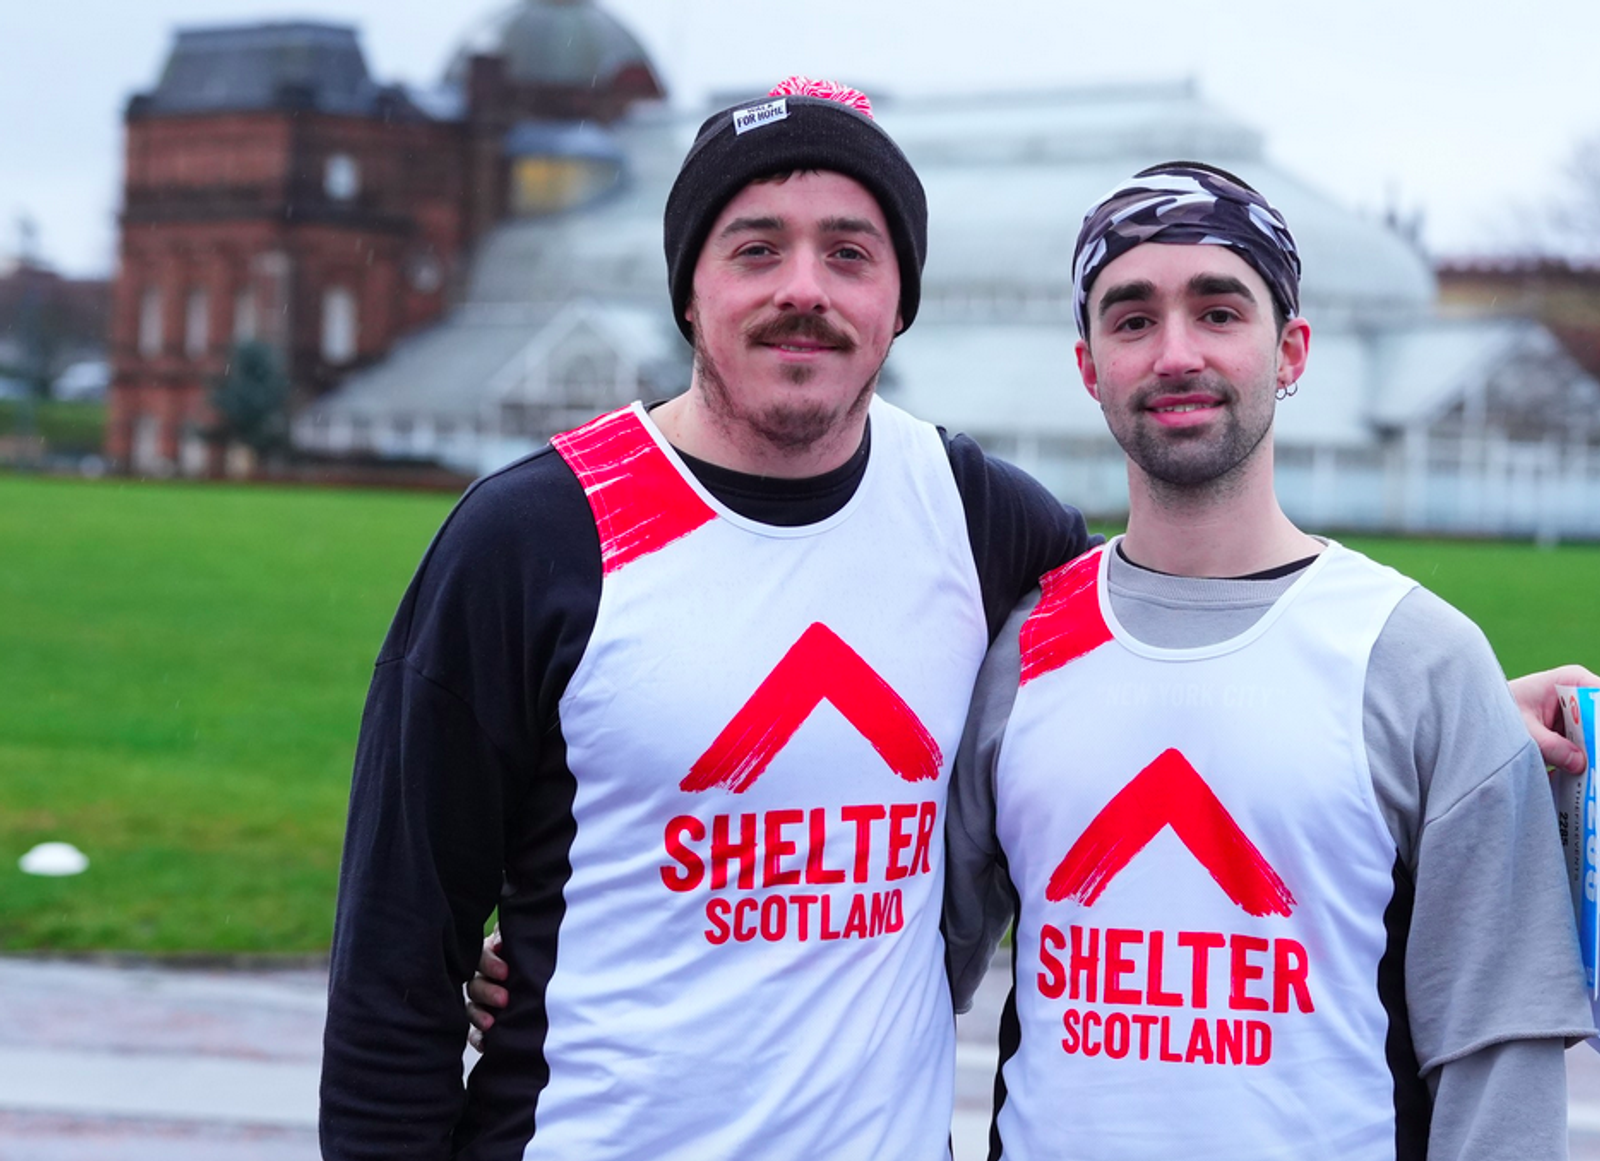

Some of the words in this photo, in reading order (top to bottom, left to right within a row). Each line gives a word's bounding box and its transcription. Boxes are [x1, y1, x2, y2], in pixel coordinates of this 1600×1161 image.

[737, 114, 757, 127] FOR
[757, 106, 784, 121] HOME
[1106, 682, 1151, 707] NEW
[1158, 683, 1215, 708] YORK
[1222, 684, 1273, 708] CITY
[660, 801, 937, 892] SHELTER
[704, 889, 904, 945] SCOTLAND
[1037, 924, 1315, 1013] SHELTER
[1062, 1009, 1272, 1066] SCOTLAND
